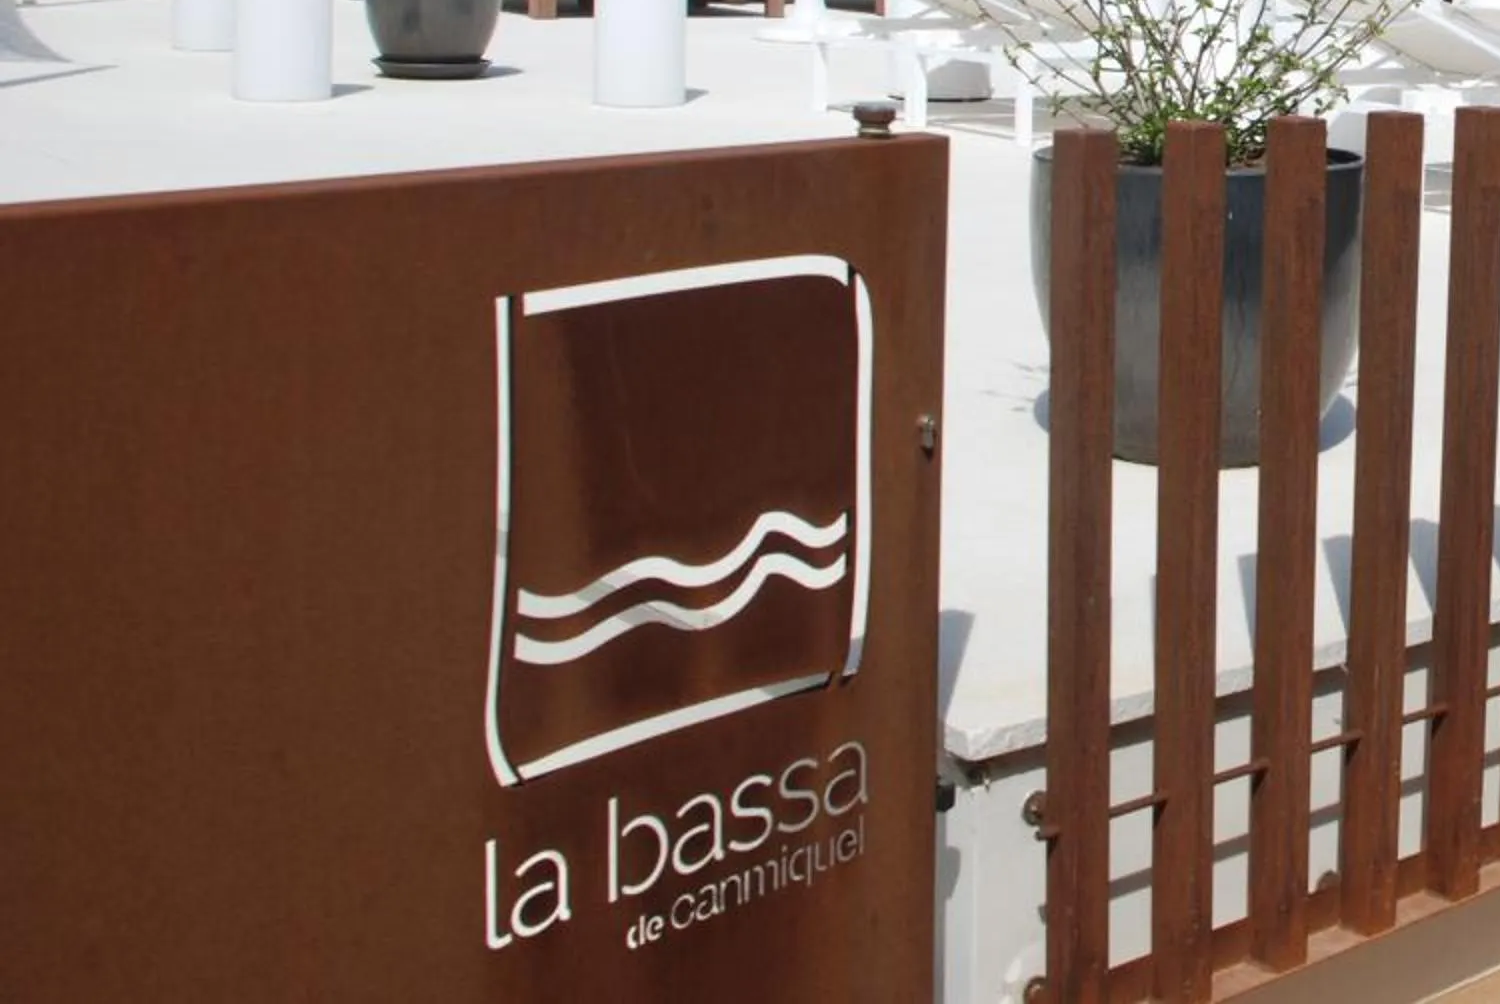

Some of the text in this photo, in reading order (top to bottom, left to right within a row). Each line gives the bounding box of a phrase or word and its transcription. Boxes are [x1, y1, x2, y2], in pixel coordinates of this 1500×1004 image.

[485, 741, 868, 950] la bassa
[626, 815, 865, 949] de canmiquel
